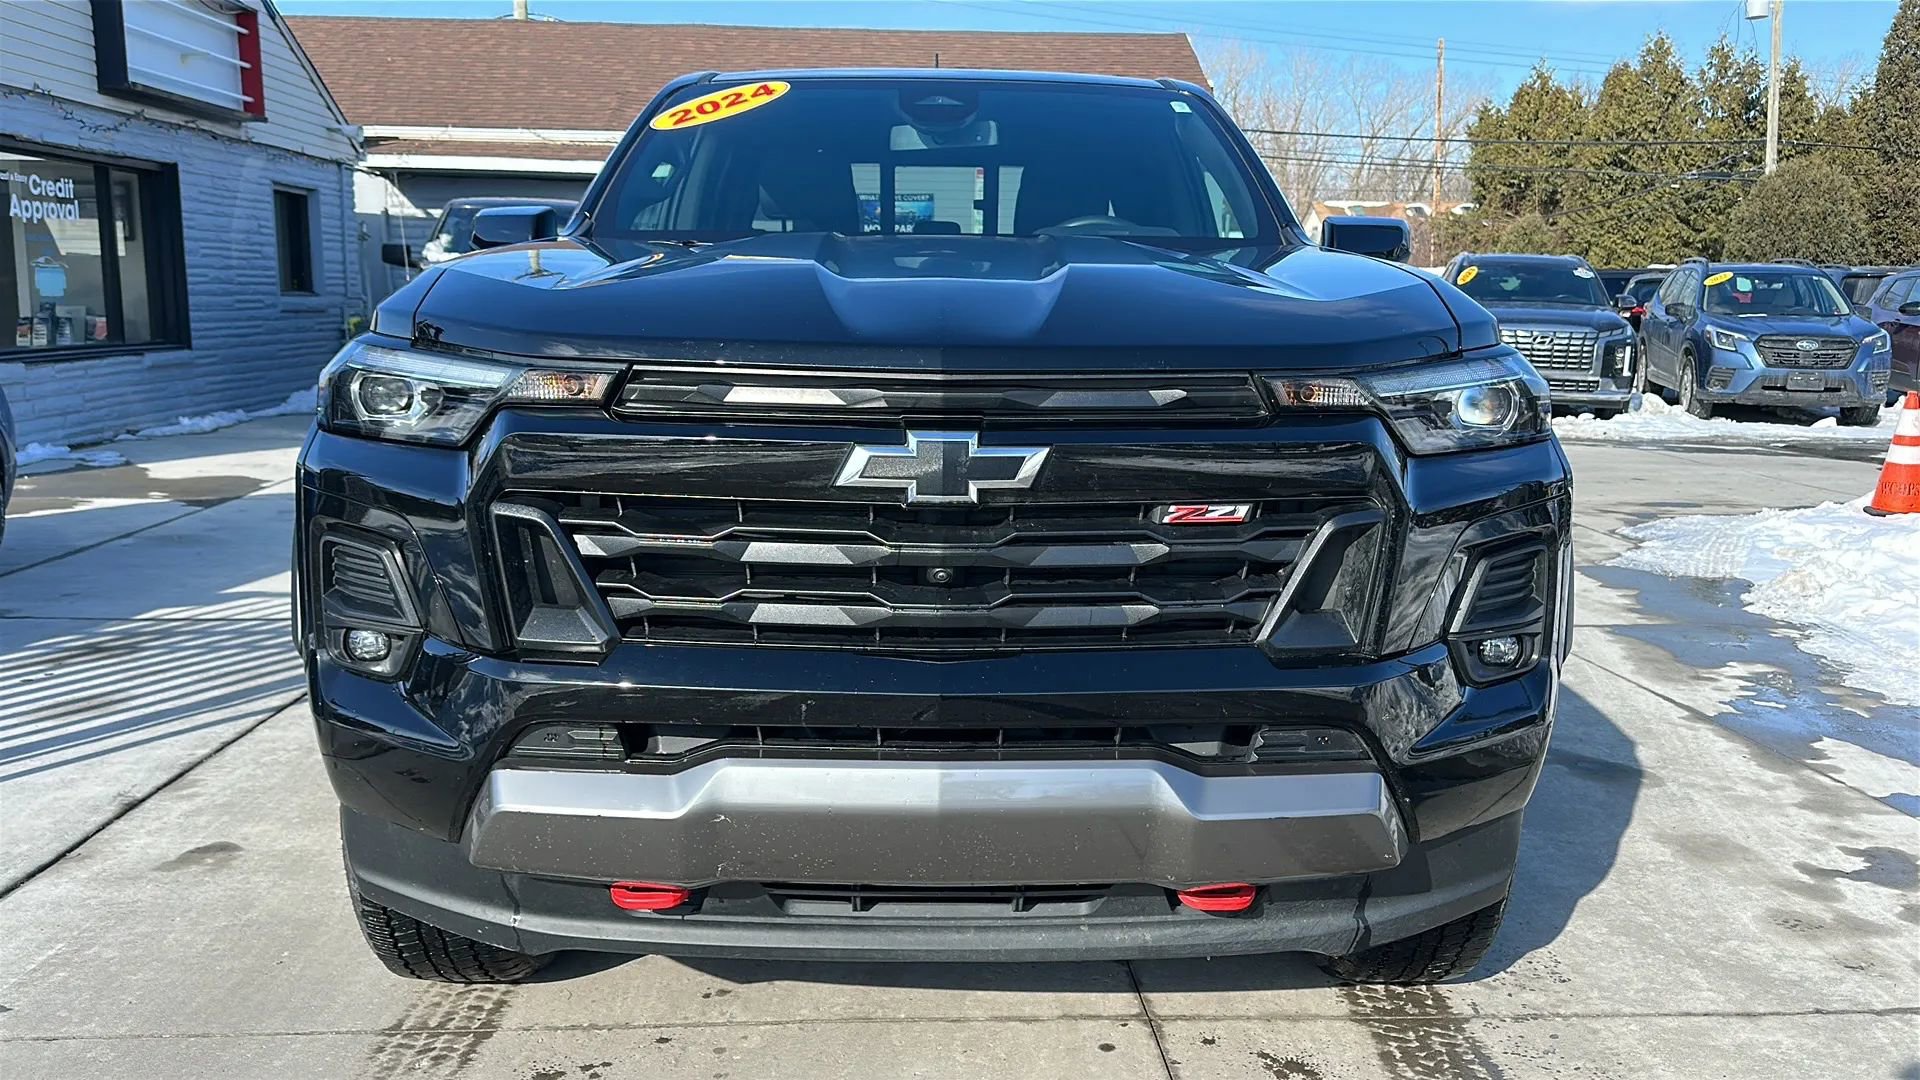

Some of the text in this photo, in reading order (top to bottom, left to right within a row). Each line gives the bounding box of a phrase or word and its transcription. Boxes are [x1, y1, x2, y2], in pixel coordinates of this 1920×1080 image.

[668, 84, 777, 126] 2024
[29, 174, 74, 198] Credit
[9, 193, 80, 224] Approval
[1162, 505, 1250, 523] Z71
